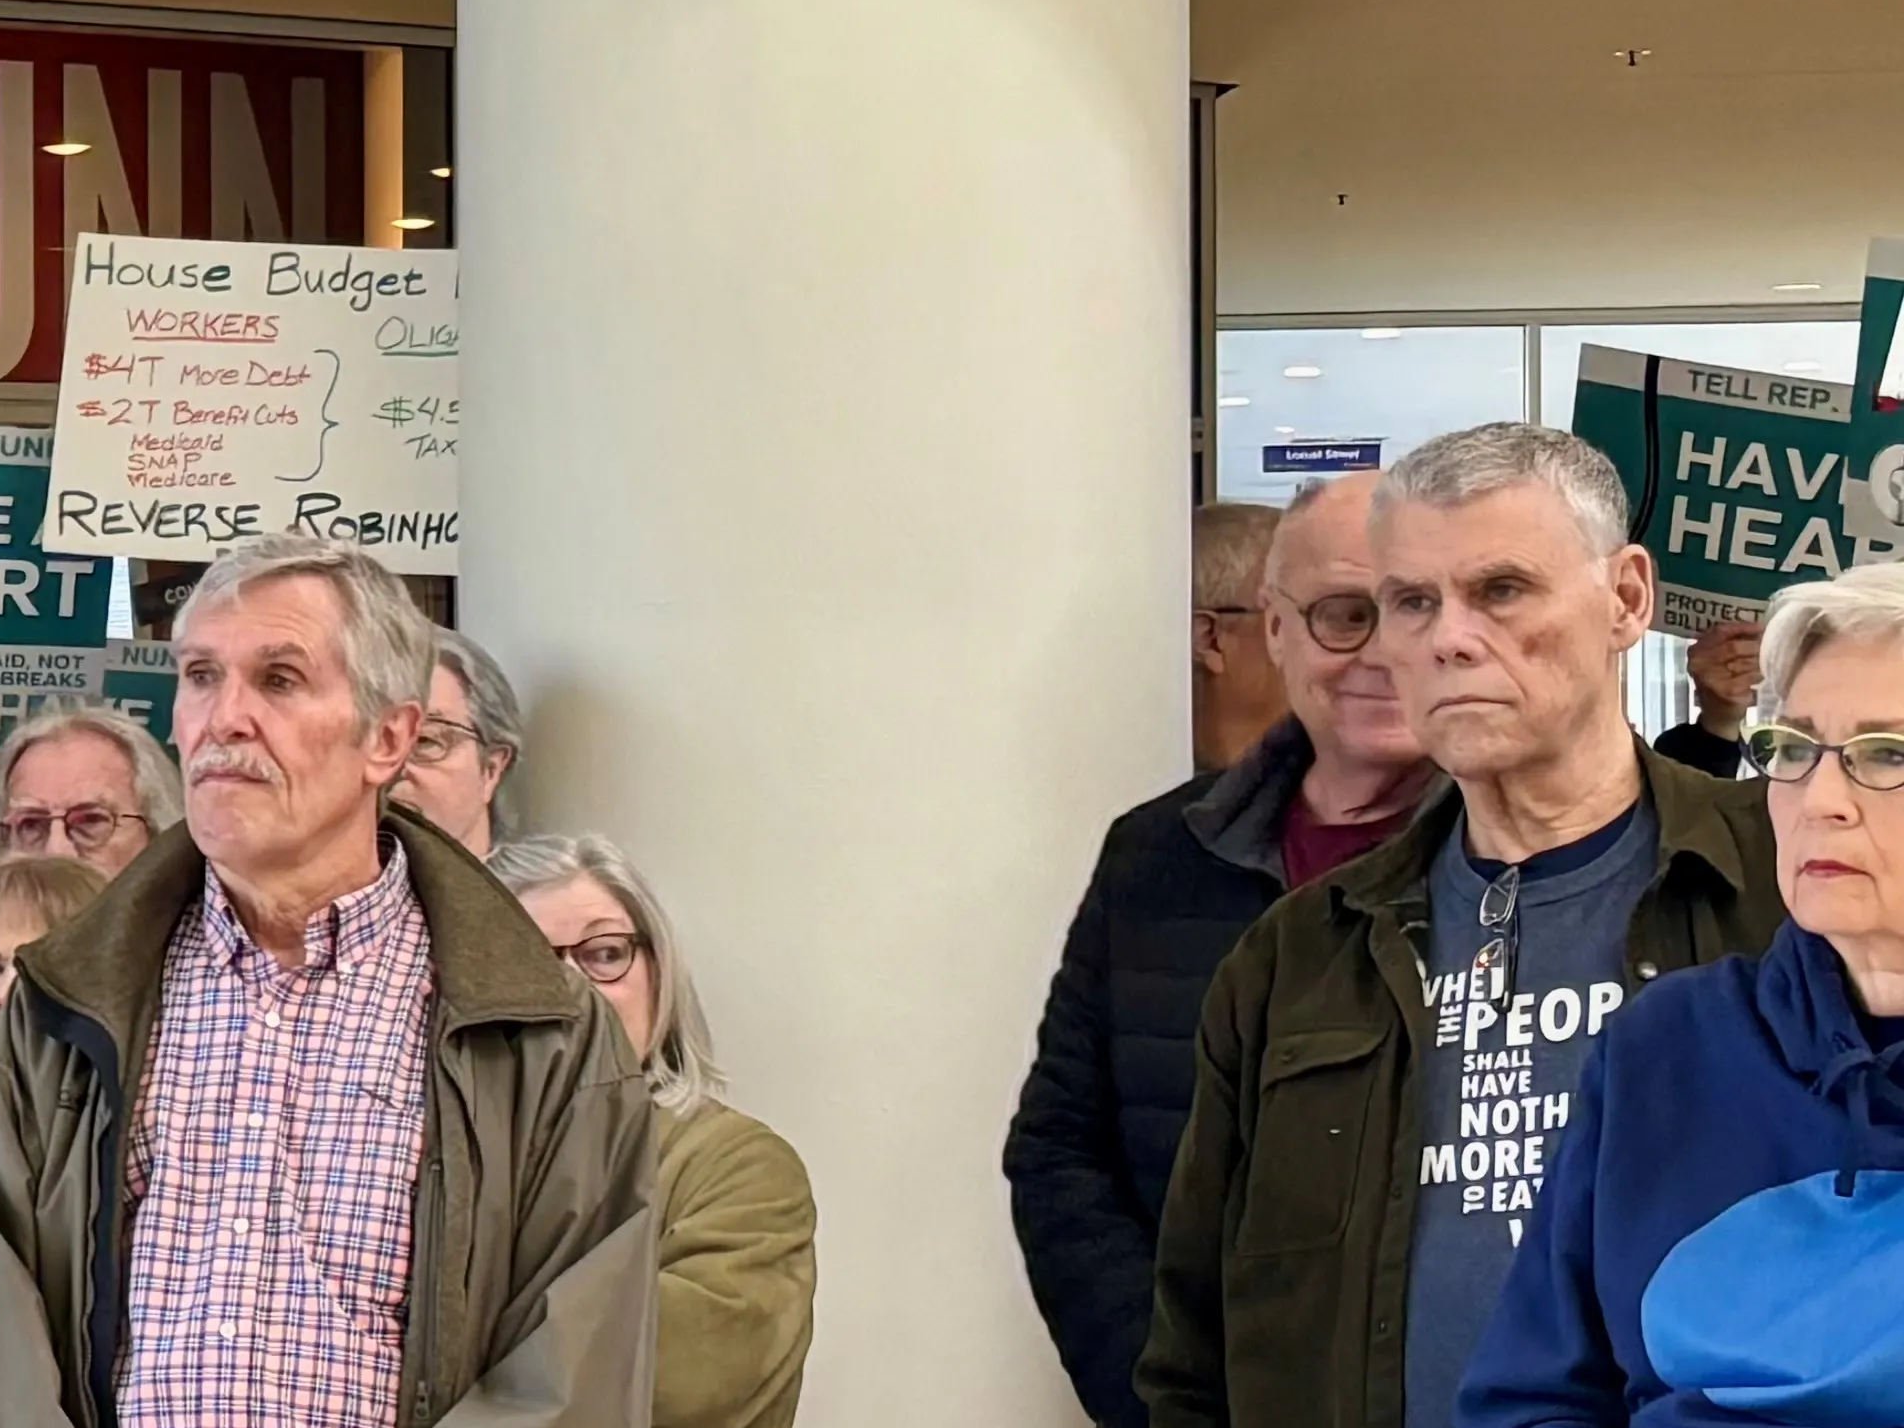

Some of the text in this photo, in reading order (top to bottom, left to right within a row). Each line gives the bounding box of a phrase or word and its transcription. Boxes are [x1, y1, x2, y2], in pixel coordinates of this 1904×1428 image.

[84, 241, 233, 293] House
[266, 252, 427, 312] Budget
[126, 308, 281, 339] WORKERS
[180, 363, 239, 386] More
[243, 359, 312, 387] Debt
[1688, 367, 1840, 413] TELL REP.
[173, 399, 250, 427] Benefit
[253, 405, 300, 427] Cuts
[130, 432, 225, 452] Medicaid
[127, 452, 203, 472] SNAP
[1676, 430, 1848, 506] HAV
[127, 471, 237, 489] Medicare
[57, 490, 264, 543] REVERSE
[38, 654, 86, 671] NOT
[0, 672, 87, 689] BREAKS
[1435, 1003, 1462, 1048] THE
[1463, 980, 1624, 1051] PEOP
[1462, 1049, 1534, 1073] SHALL
[1461, 1070, 1532, 1100] HAVE
[1460, 1091, 1570, 1139] NOTH
[1419, 1135, 1545, 1185] MORE
[1462, 1184, 1485, 1215] TO
